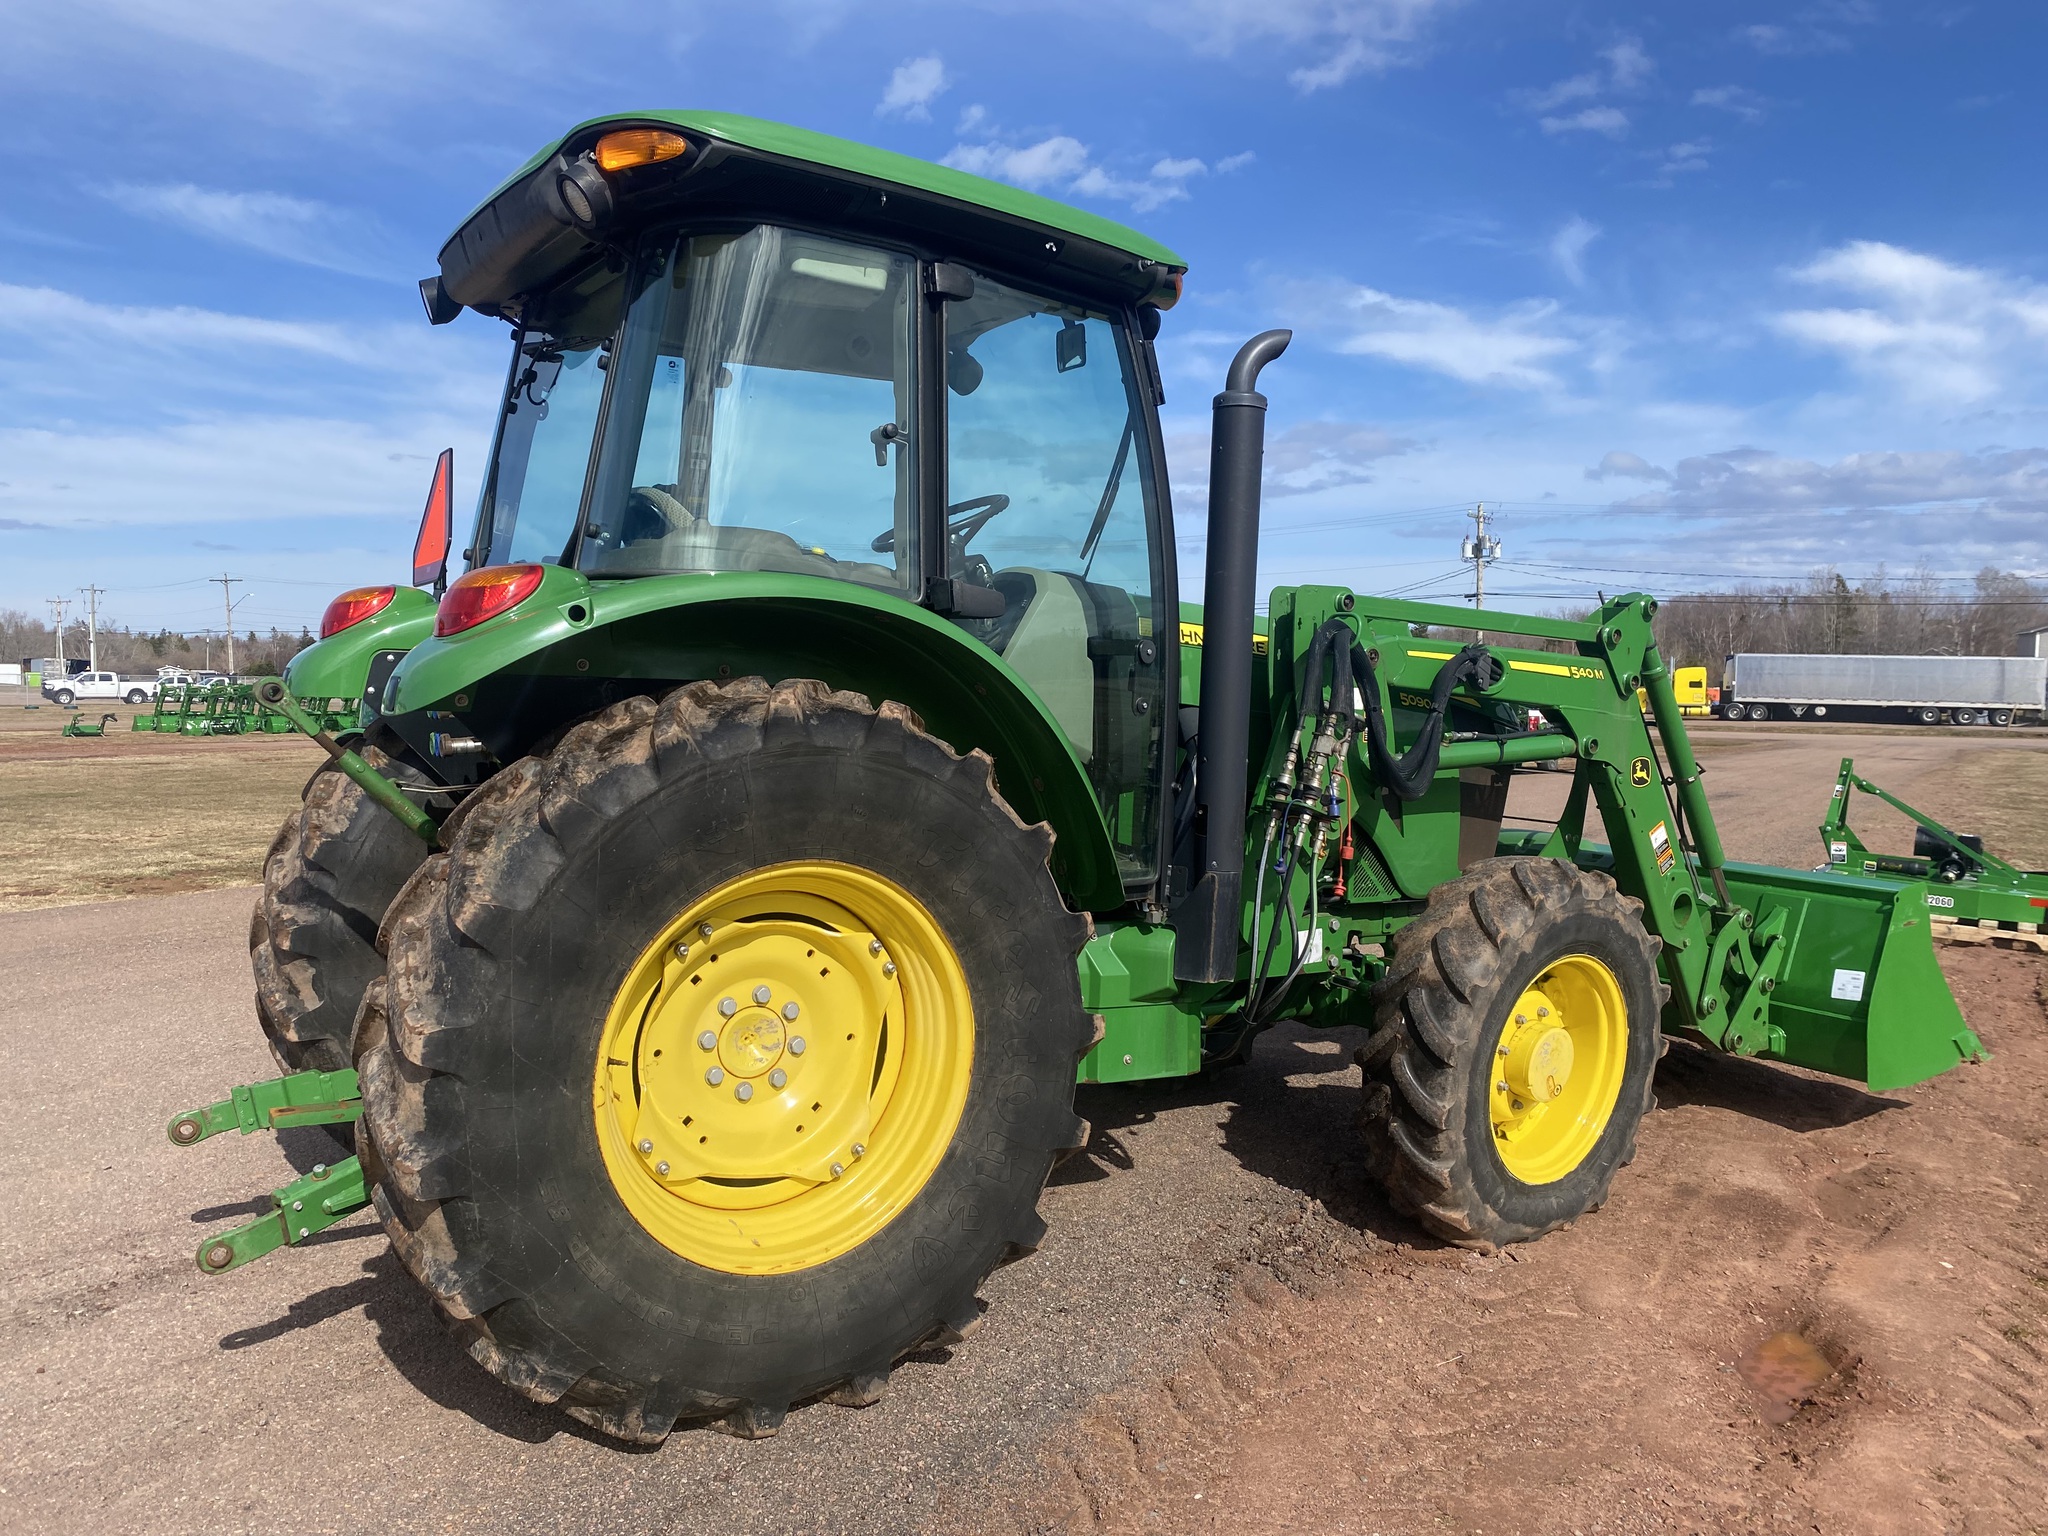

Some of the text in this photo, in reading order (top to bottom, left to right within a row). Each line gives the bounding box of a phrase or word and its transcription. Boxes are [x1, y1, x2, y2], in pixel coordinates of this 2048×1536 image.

[1400, 692, 1432, 709] 5090
[1928, 896, 1954, 907] 2060
[917, 822, 1043, 1232] Firestone
[567, 1232, 780, 1346] PERFORMER
